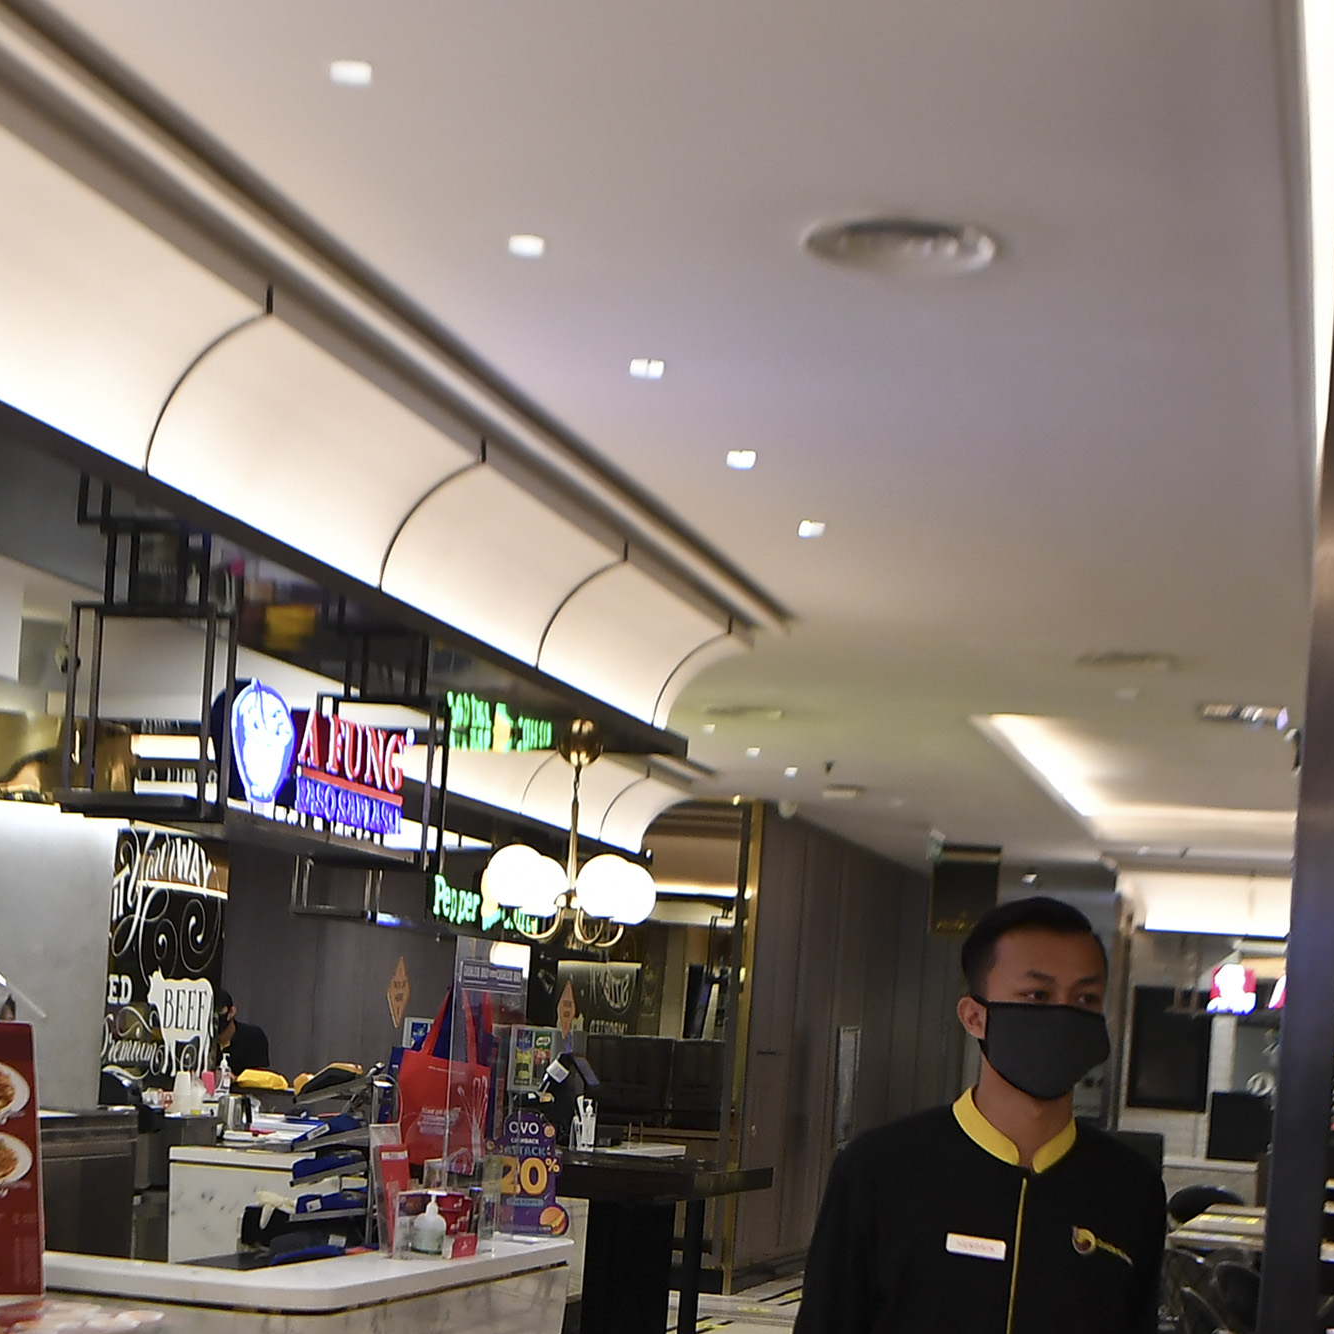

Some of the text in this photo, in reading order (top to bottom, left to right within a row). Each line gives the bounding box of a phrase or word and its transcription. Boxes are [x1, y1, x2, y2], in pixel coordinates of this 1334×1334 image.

[297, 706, 321, 767] A
[326, 713, 405, 793] FUNG
[433, 873, 481, 925] Pepper
[108, 972, 133, 1004] ED
[164, 988, 208, 1031] BEEF
[509, 1120, 540, 1136] OVO
[501, 1157, 561, 1196] 20%
